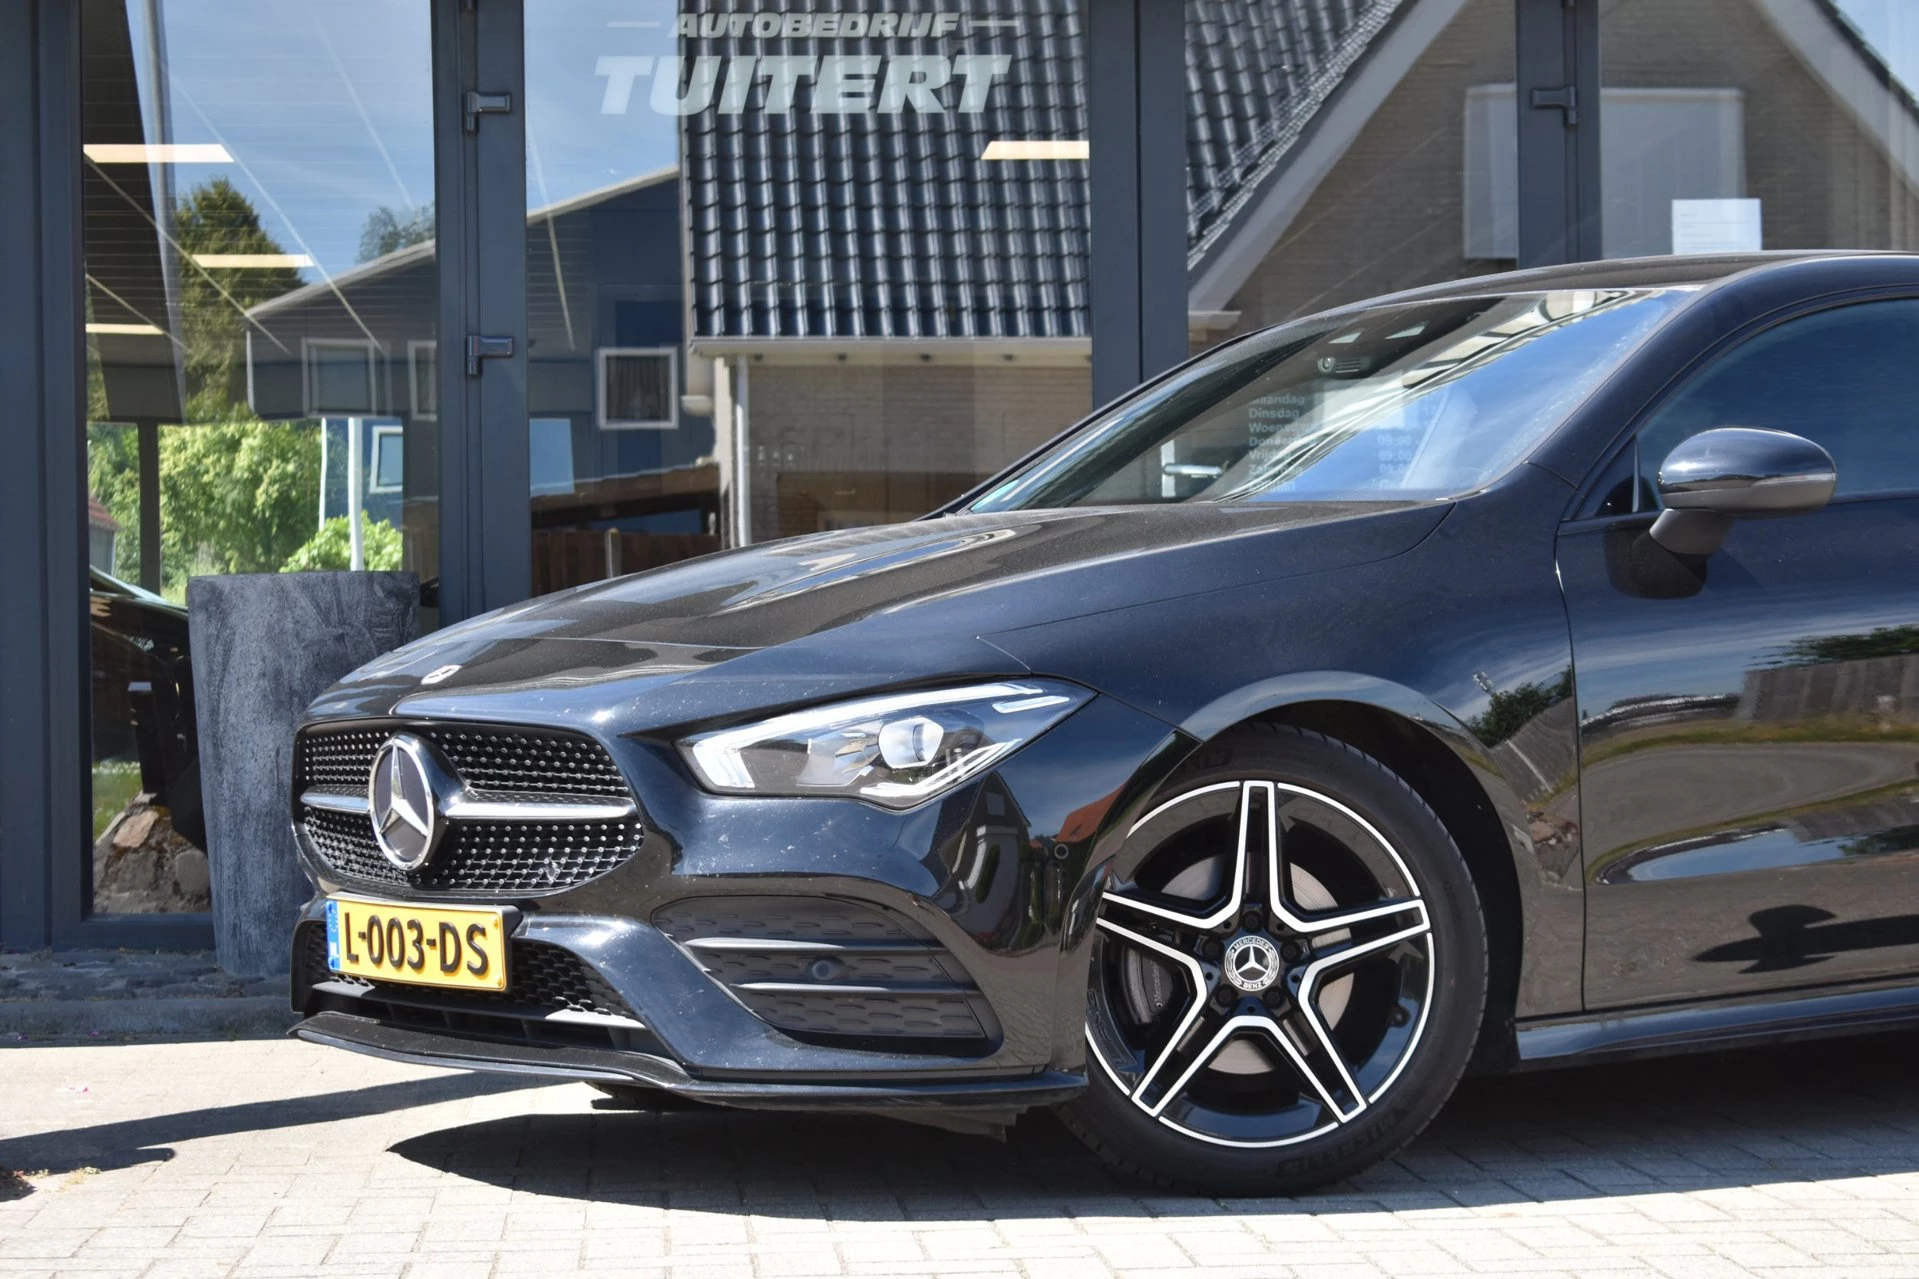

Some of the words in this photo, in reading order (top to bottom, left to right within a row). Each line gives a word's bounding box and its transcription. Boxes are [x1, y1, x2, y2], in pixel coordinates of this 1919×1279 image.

[668, 12, 960, 38] AUTOBEDRIJF
[594, 54, 1012, 115] TUITERT
[1248, 407, 1301, 420] Dinsdag
[344, 911, 489, 977] L-003-DS
[1233, 937, 1270, 950] MERCEDES
[1242, 981, 1264, 990] BENZ
